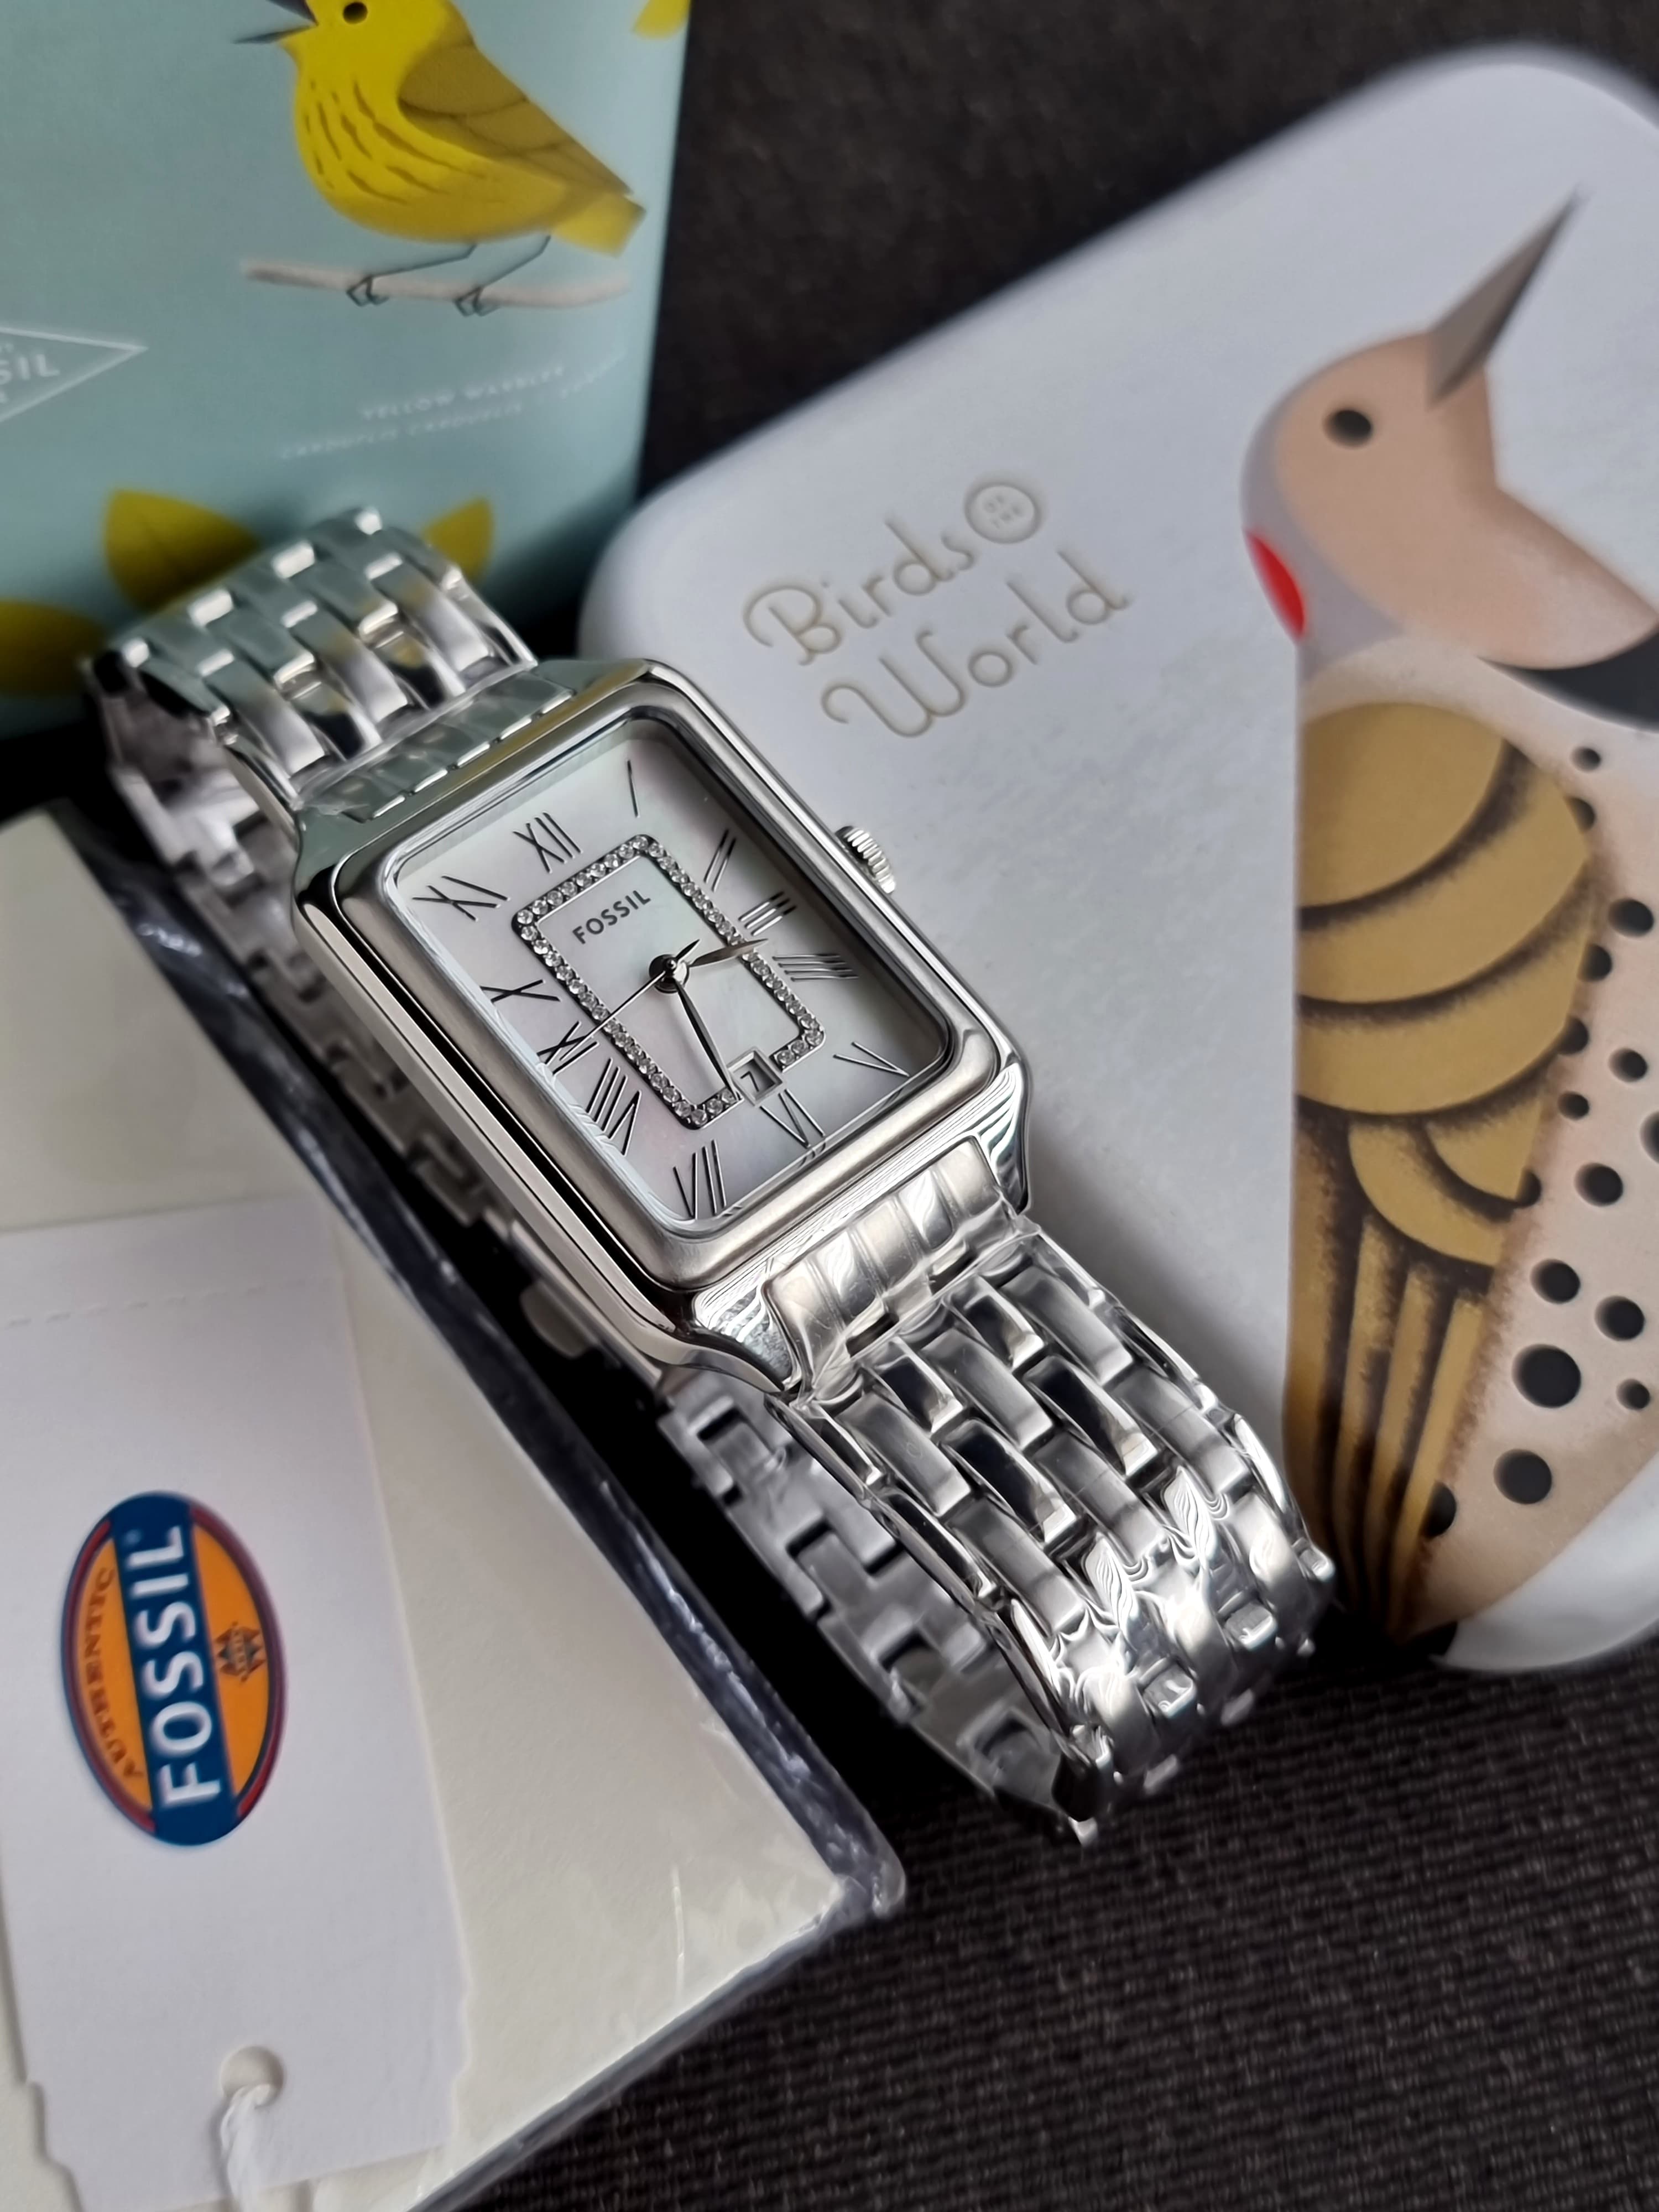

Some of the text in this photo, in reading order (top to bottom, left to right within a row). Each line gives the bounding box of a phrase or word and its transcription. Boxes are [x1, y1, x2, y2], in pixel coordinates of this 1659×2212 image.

[742, 515, 977, 665] Birds
[821, 549, 1133, 738] World
[513, 812, 581, 874] XII
[412, 874, 511, 922] XI
[572, 890, 651, 945] FOSSIL
[479, 979, 561, 1003] X
[739, 1070, 760, 1093] 7
[833, 1041, 911, 1077] V
[759, 1088, 826, 1149] VI
[672, 1139, 728, 1220] VII
[85, 1567, 145, 1779] AUTHENTIC
[125, 1525, 221, 1809] FOSSIL
